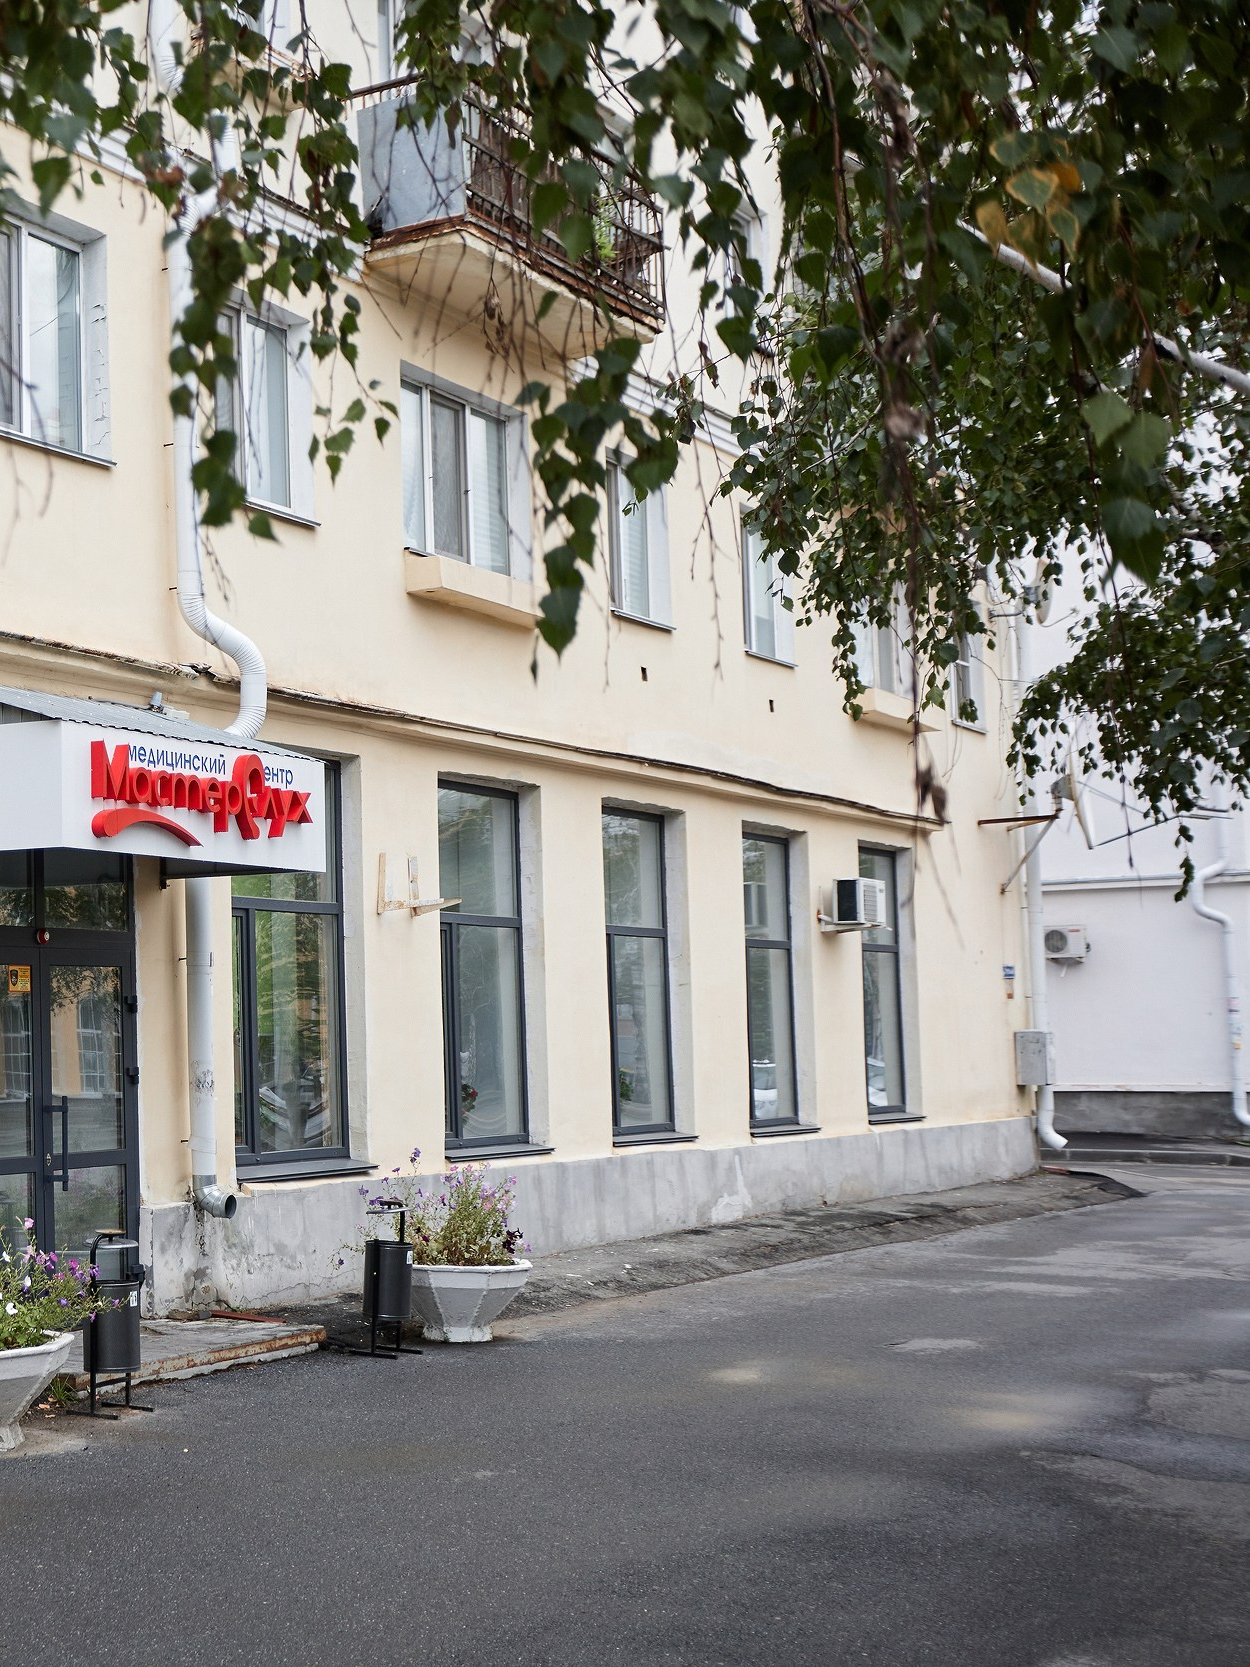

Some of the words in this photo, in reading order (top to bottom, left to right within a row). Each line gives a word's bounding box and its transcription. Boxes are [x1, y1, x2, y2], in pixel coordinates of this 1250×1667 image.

[90, 738, 314, 840] МастерСлух
[127, 743, 227, 775] медицинский
[263, 766, 294, 788] ентр
